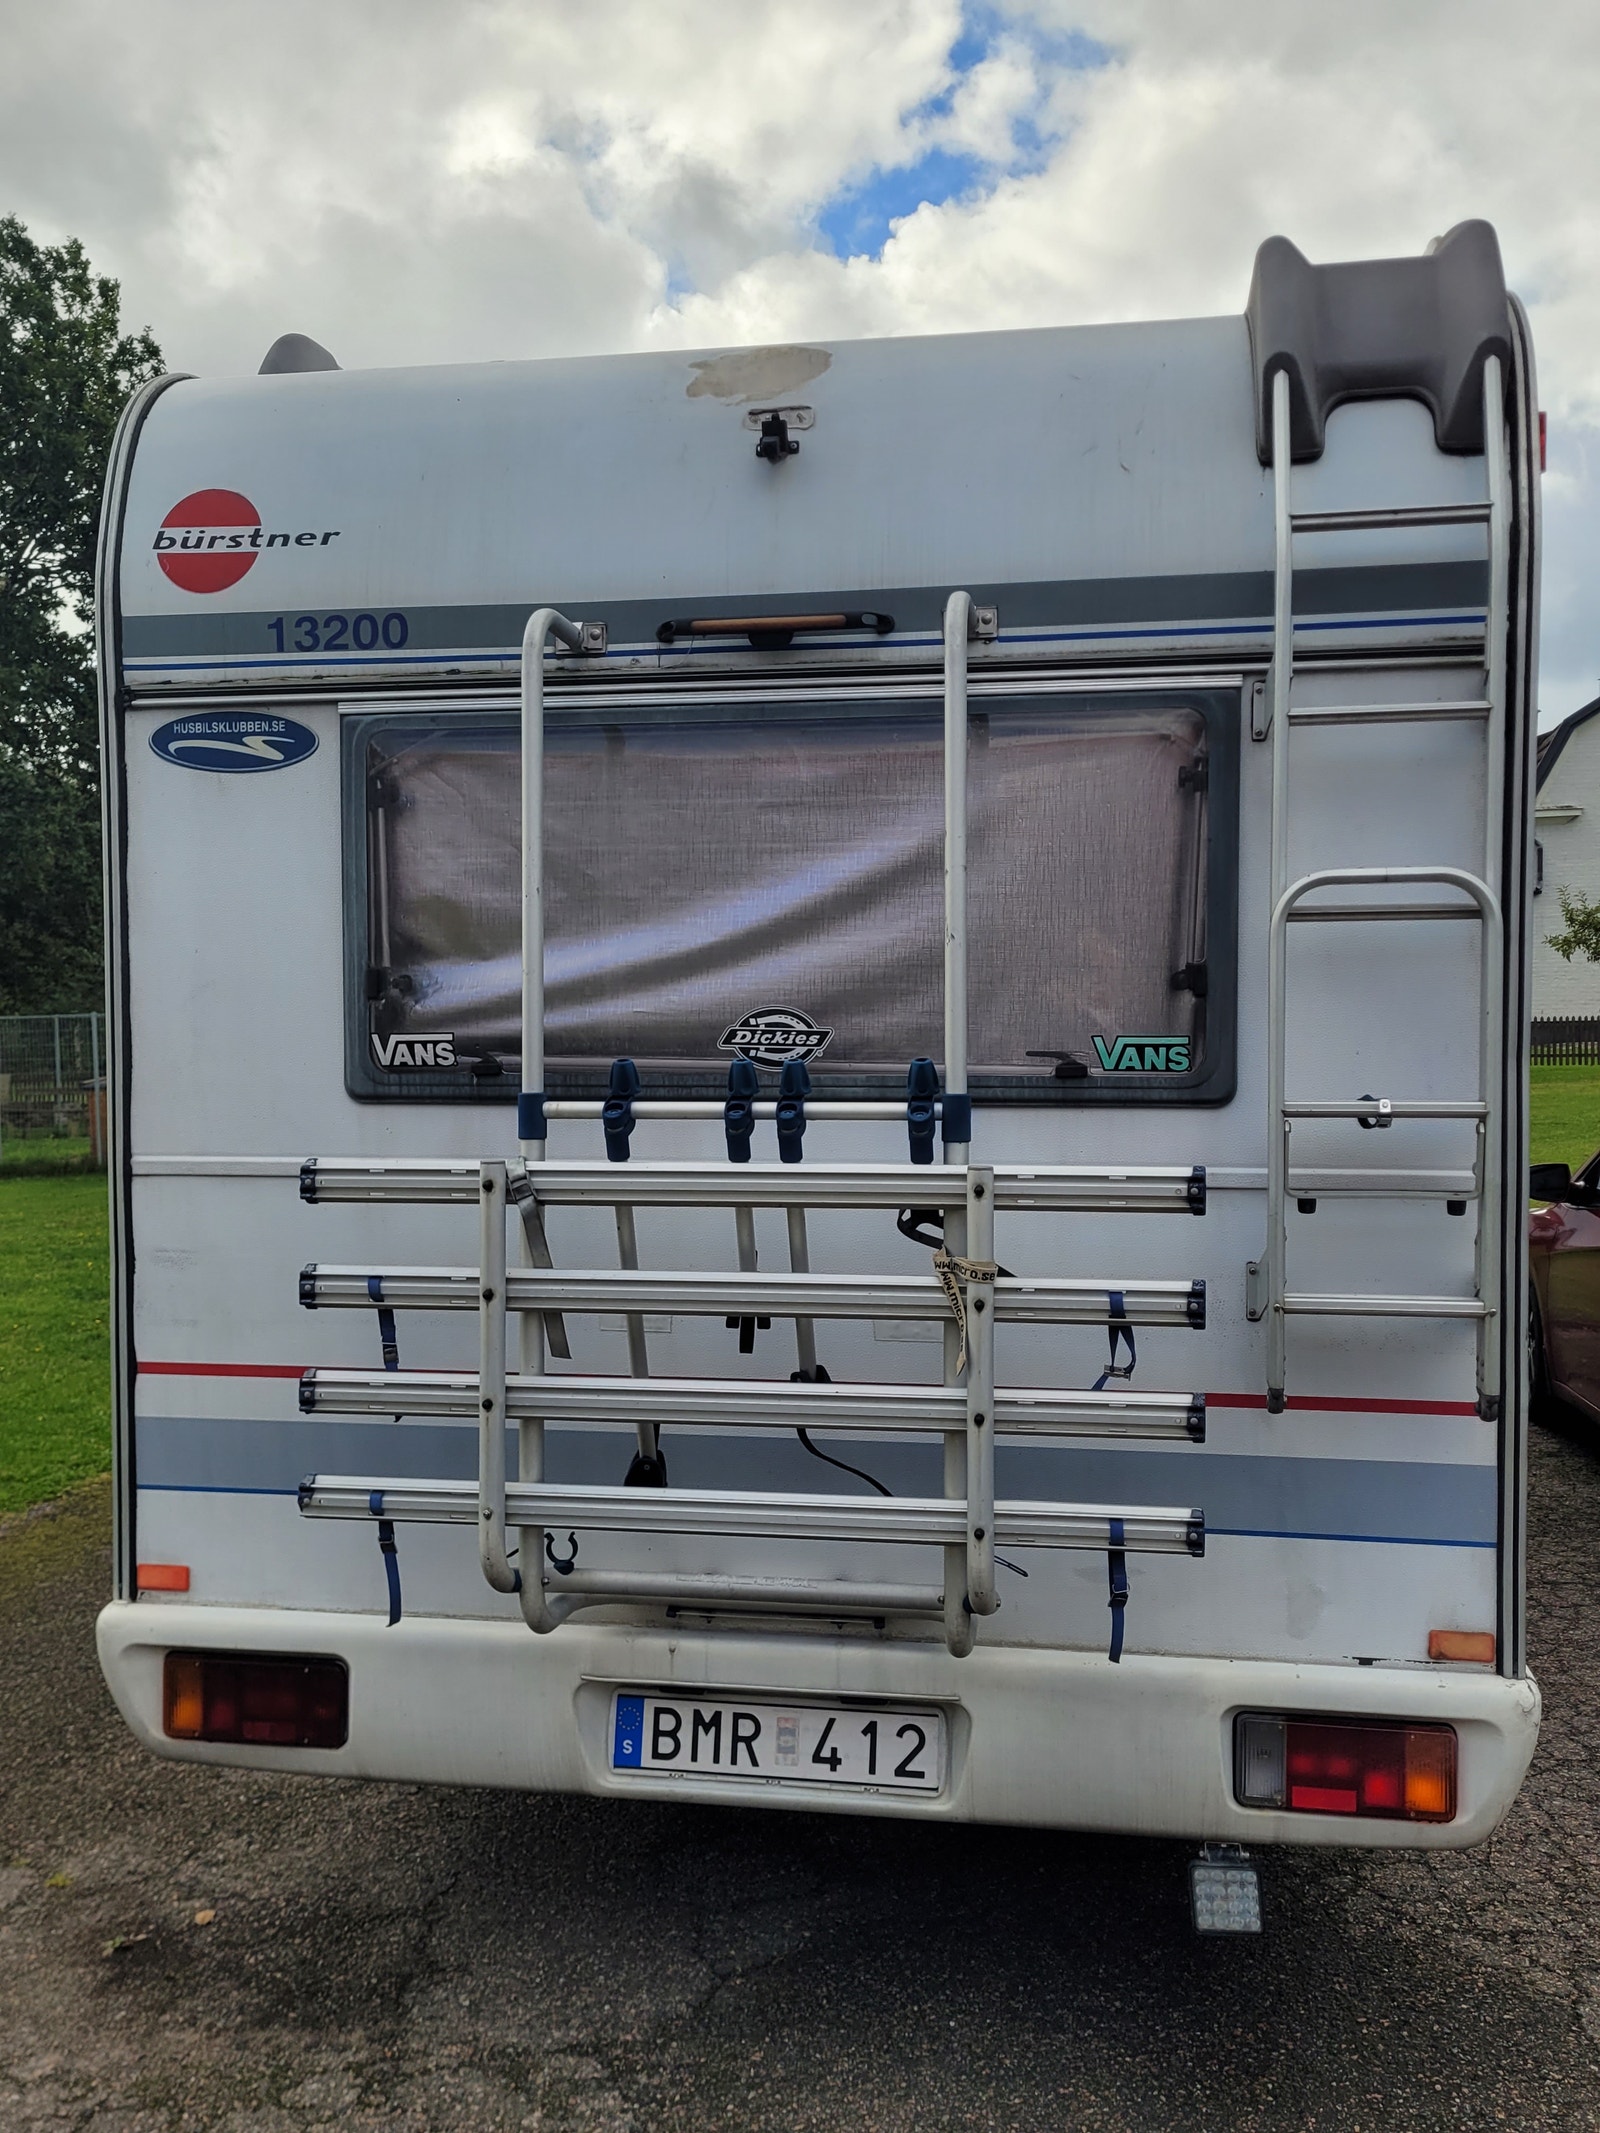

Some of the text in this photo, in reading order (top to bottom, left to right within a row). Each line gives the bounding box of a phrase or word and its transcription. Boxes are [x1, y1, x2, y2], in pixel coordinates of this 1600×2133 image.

[152, 528, 341, 550] bürstner
[267, 612, 409, 652] 13200
[174, 721, 286, 733] HUSBILSKLUBBEN.SE
[371, 1034, 455, 1066] VANS
[731, 1031, 820, 1045] Dickies
[1092, 1036, 1189, 1071] VANS
[622, 1739, 633, 1755] S
[651, 1706, 927, 1779] BMR 412
